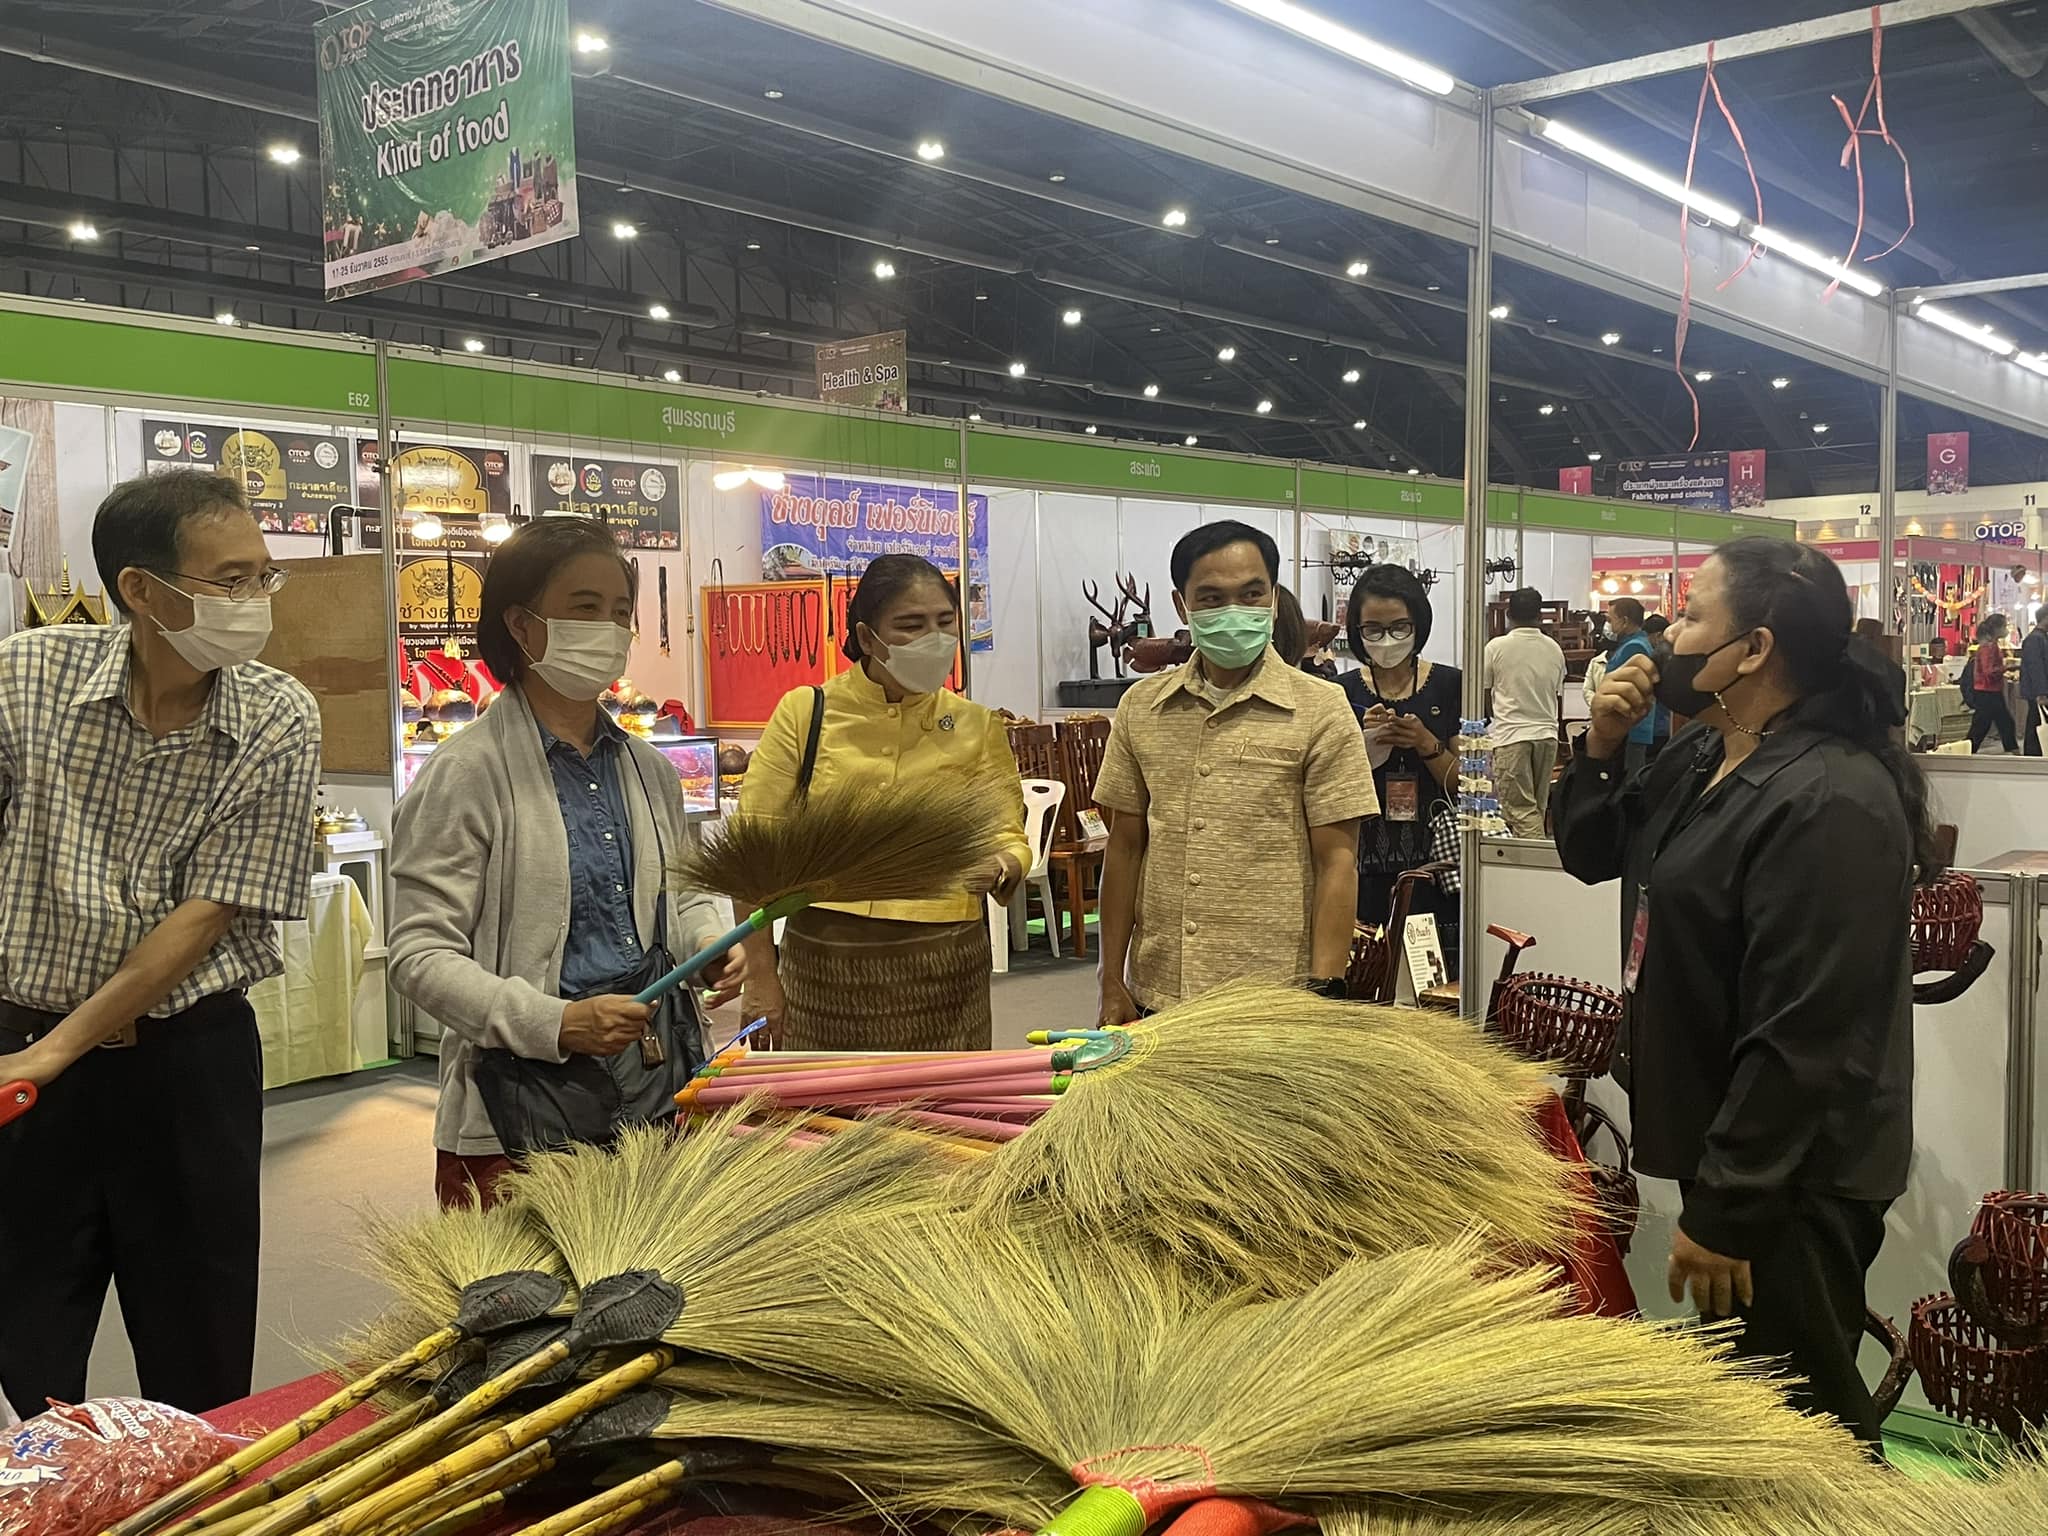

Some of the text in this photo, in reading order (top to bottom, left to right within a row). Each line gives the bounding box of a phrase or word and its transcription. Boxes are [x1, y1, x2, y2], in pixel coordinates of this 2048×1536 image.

[376, 100, 510, 178] Kind of food
[373, 255, 389, 269] 2565
[822, 363, 898, 391] Health & Spa
[348, 391, 370, 408] E62
[661, 406, 737, 440] สุพรรณบุรี
[1939, 448, 1957, 464] G
[1740, 465, 1753, 480] H
[246, 479, 265, 488] TOP
[1631, 489, 1714, 502] Fabric type and clothing
[2023, 494, 2036, 506] 11
[1859, 504, 1871, 515] 12
[1975, 523, 2025, 539] OTOP
[441, 539, 448, 548] 4
